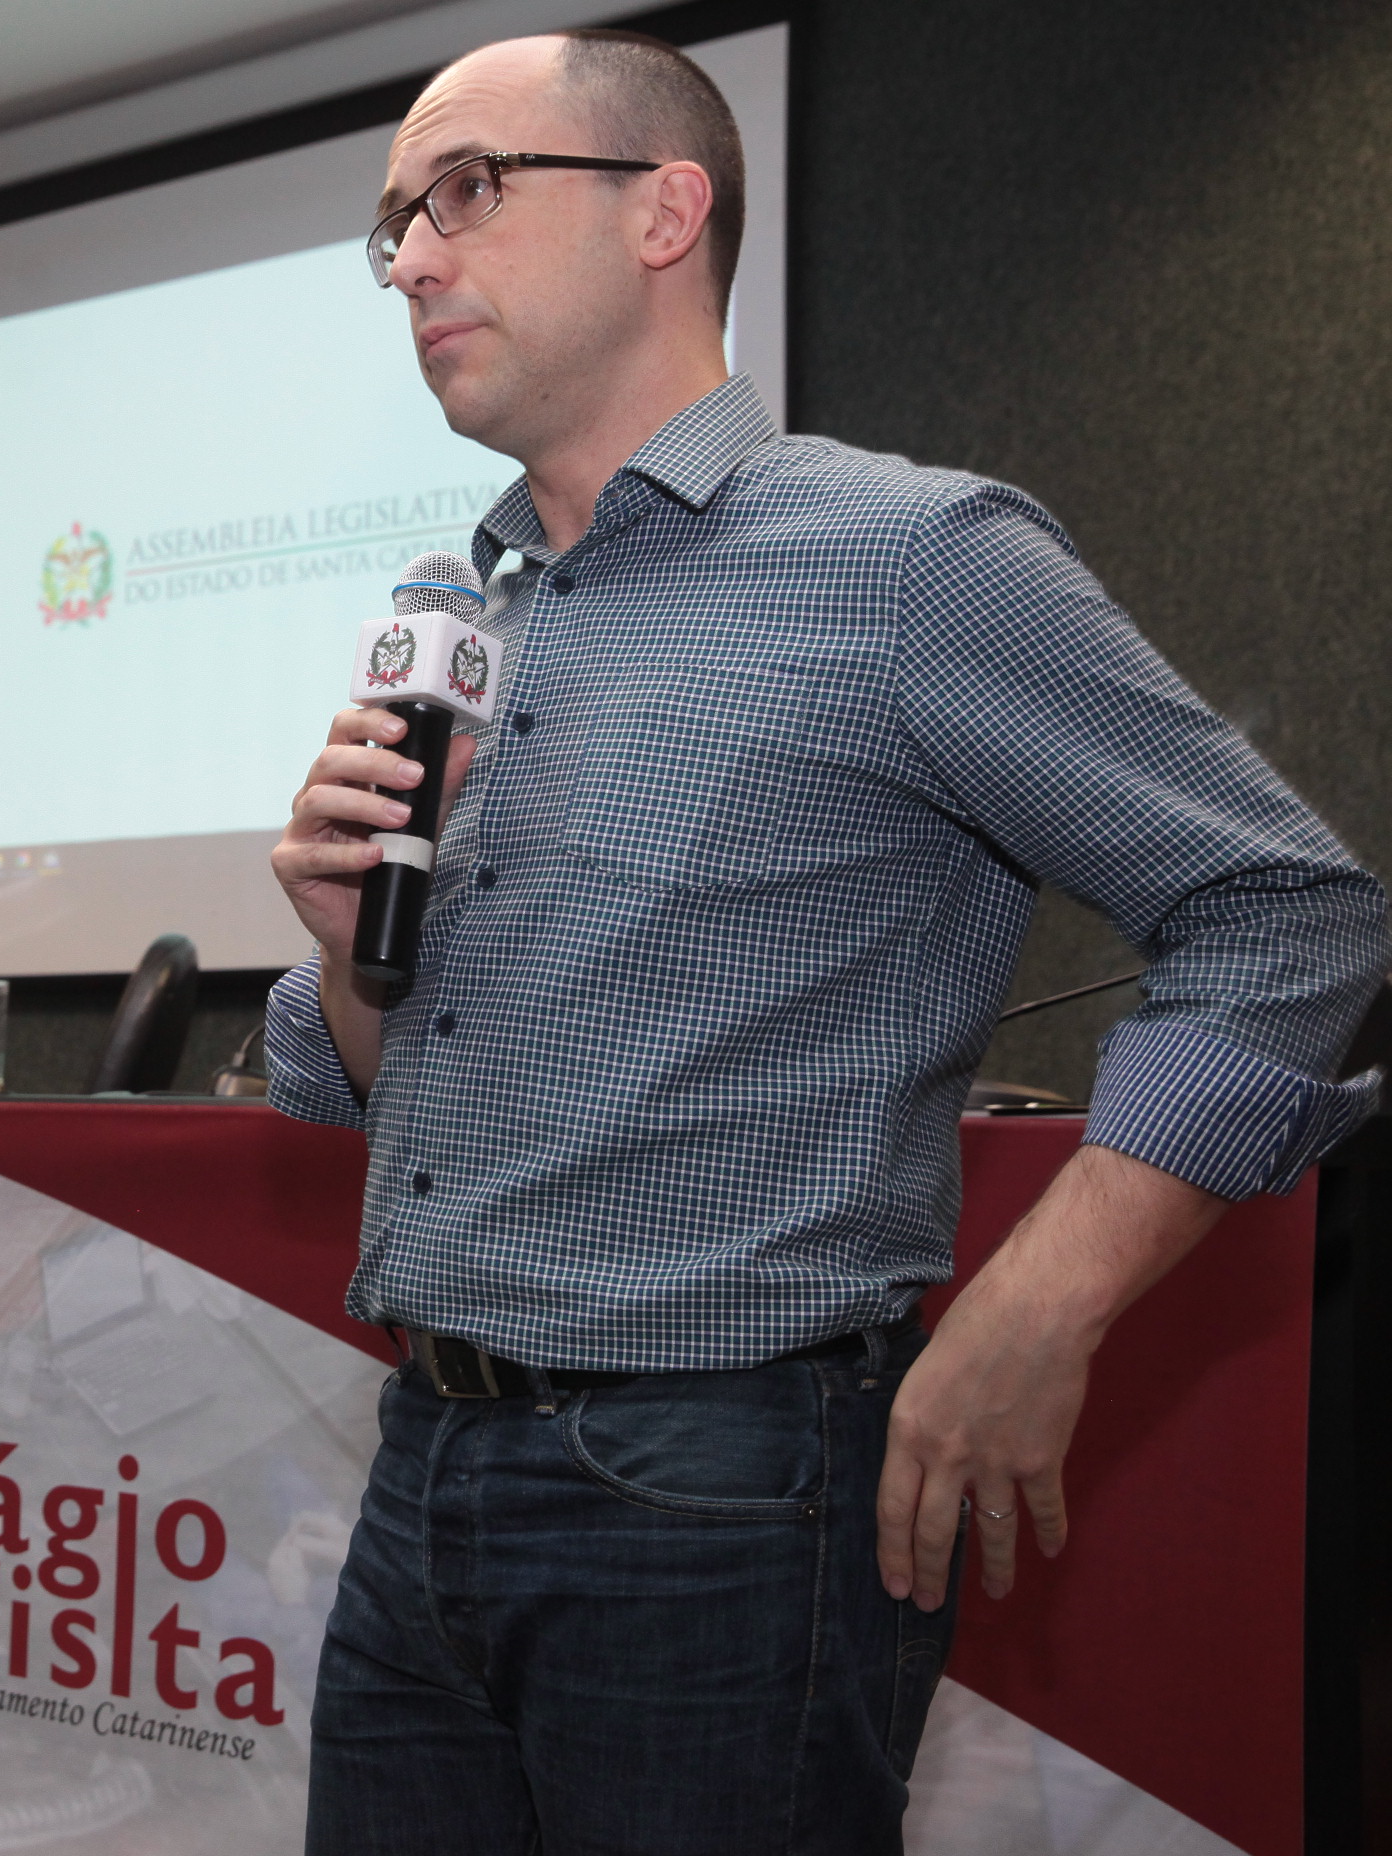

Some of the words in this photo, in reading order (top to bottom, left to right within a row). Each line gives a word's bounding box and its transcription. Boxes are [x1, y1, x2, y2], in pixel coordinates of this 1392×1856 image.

[126, 513, 298, 564] ASSEMBLEIA
[123, 579, 161, 605] DO
[164, 565, 254, 600] ESTADO
[258, 560, 289, 587] DE
[294, 549, 372, 583] SANTA
[92, 1700, 256, 1761] Catarinense
